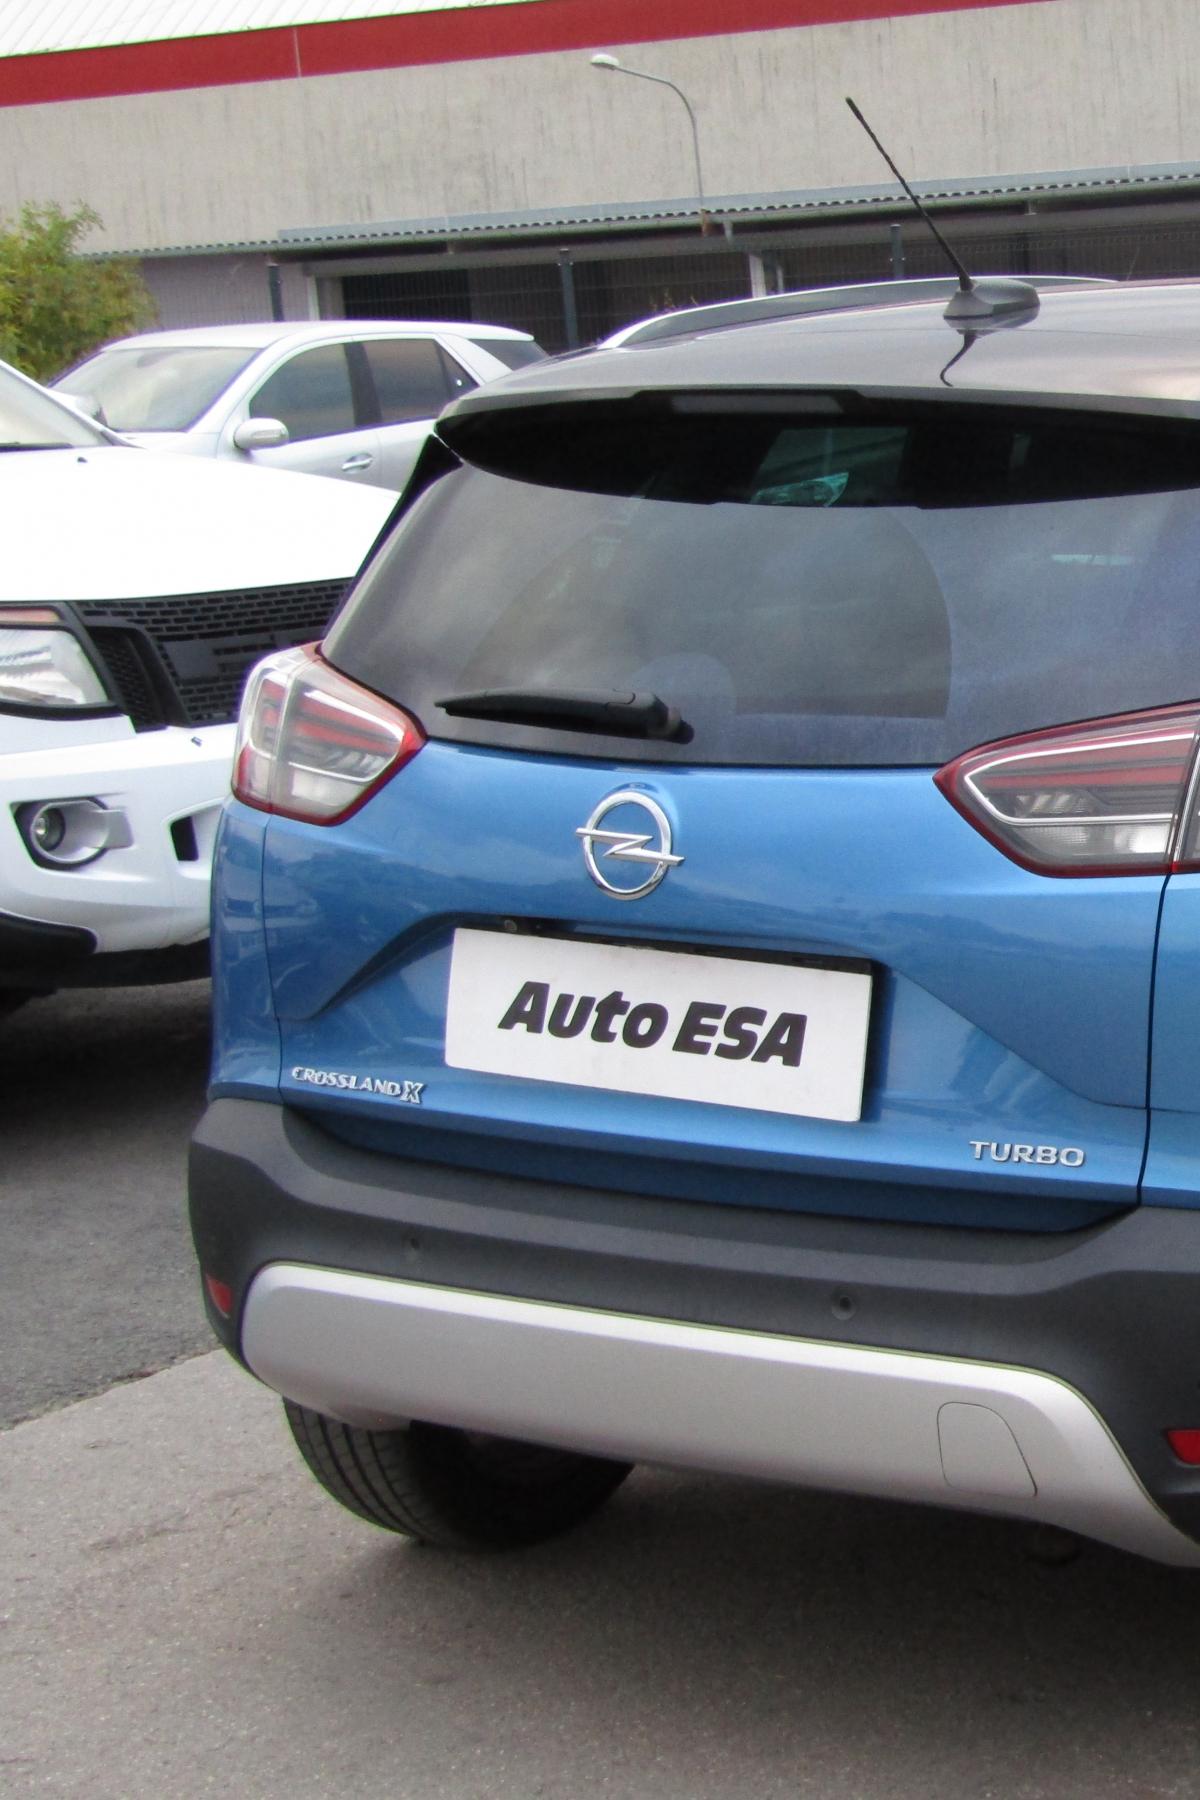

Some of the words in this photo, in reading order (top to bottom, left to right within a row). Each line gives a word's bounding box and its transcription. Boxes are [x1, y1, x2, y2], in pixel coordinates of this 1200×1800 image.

[497, 981, 669, 1048] Auto
[672, 1001, 807, 1067] ESA
[969, 1140, 1084, 1167] TURBO
